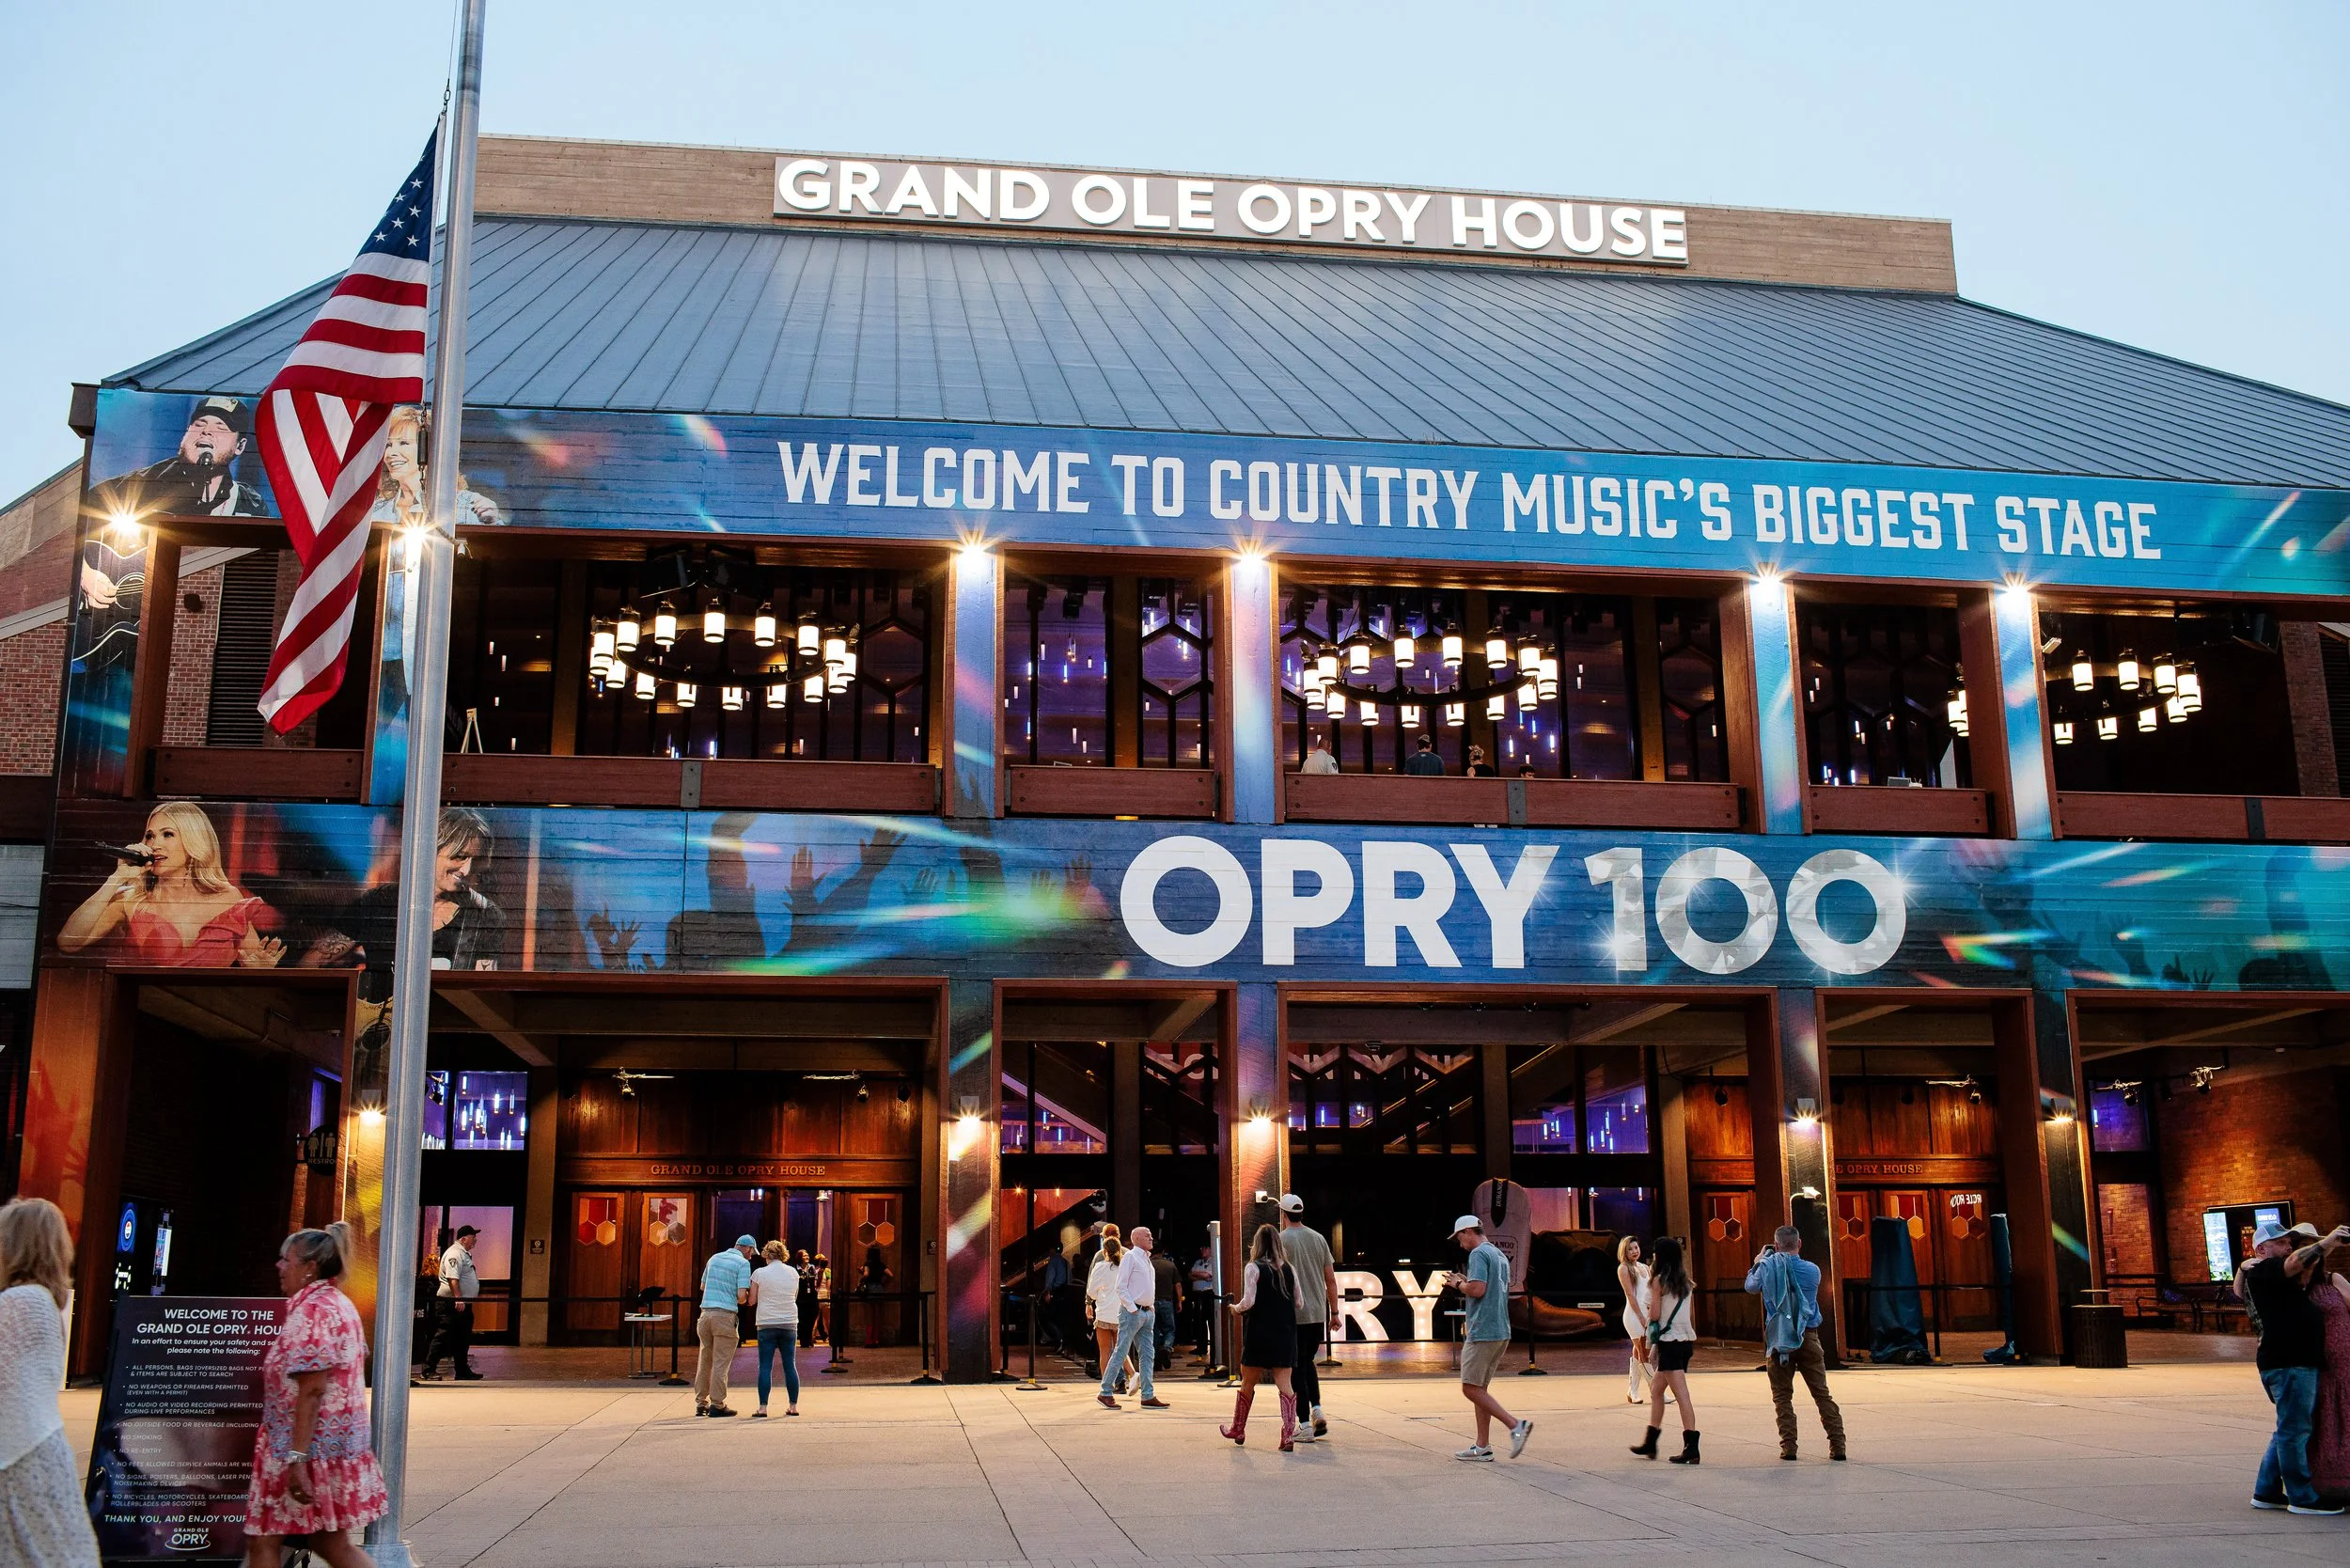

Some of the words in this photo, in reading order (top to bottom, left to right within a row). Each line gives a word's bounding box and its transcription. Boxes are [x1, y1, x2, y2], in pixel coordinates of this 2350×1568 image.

[778, 159, 1050, 222] GRAND
[1072, 175, 1214, 232] OLE
[1237, 183, 1432, 244] OPRY
[1451, 196, 1686, 260] HOUSE
[776, 441, 1089, 513] WELCOME
[1111, 454, 1184, 517] TO
[1210, 459, 1479, 529] COUNTRY
[1502, 471, 1732, 541] MUSIC'S
[1752, 483, 1974, 551] BIGGEST
[1995, 495, 2161, 559] STAGE
[1120, 836, 1560, 969] OPRY
[1585, 847, 1906, 975] 100
[651, 1165, 701, 1175] GRAND
[707, 1166, 733, 1175] OLE
[738, 1166, 773, 1175] OPRY
[780, 1166, 825, 1175] HOUSE
[1847, 1165, 1877, 1173] OPRY
[1884, 1165, 1922, 1173] HOUSE
[1325, 1270, 1452, 1341] RY
[164, 1309, 227, 1319] WELCOME
[230, 1310, 247, 1320] TO
[251, 1310, 274, 1320] THE
[137, 1324, 182, 1333] GRAND
[186, 1324, 210, 1334] OLE
[254, 1325, 281, 1335] HOU
[226, 1347, 260, 1356] following:
[140, 1515, 162, 1524] YOU,
[171, 1533, 208, 1544] OPRY
